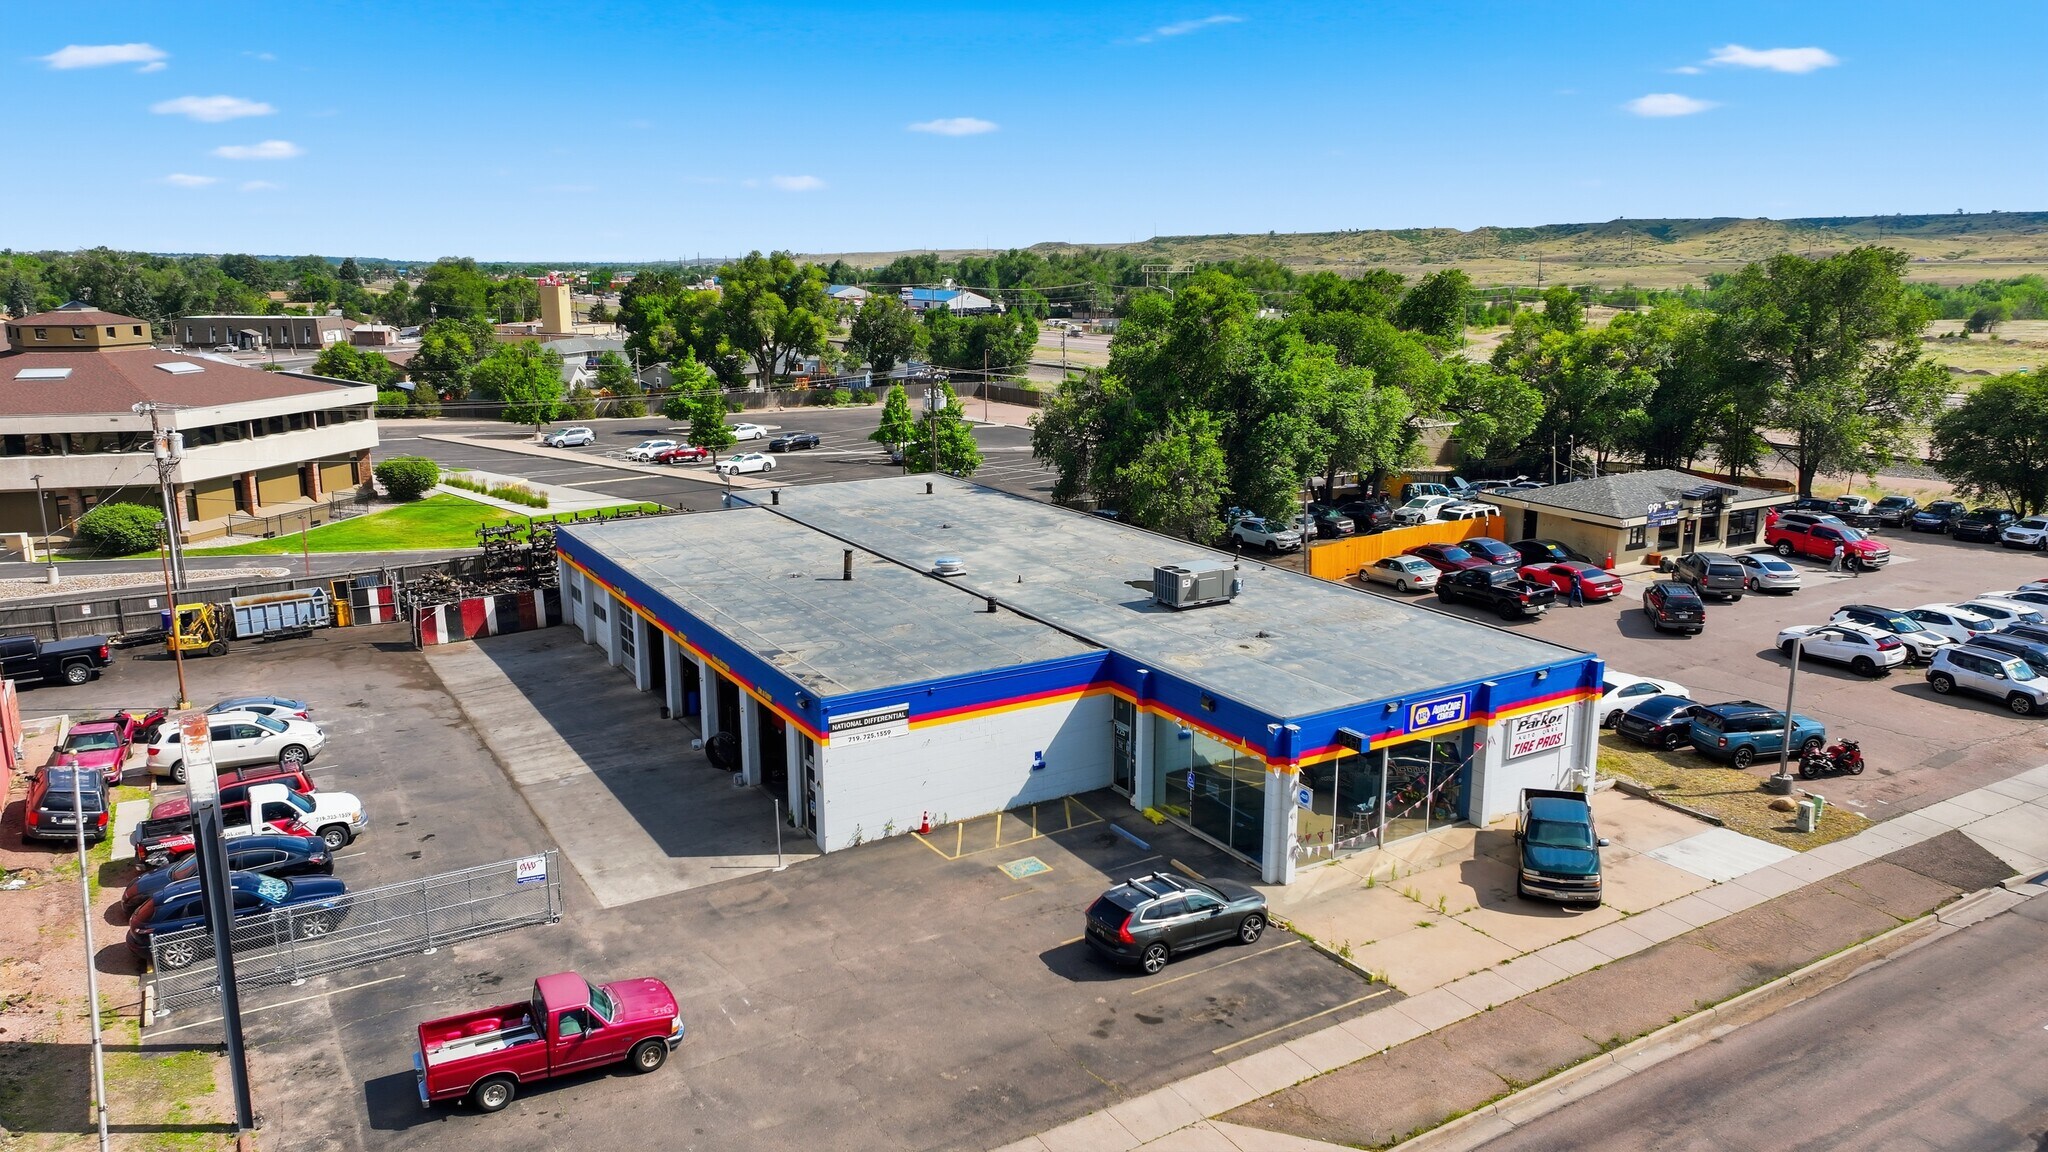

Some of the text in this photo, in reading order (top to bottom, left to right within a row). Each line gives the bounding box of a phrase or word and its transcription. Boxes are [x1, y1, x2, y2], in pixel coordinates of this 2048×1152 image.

[832, 711, 906, 731] NATIONAL DIFFERENTIAL
[848, 729, 892, 742] 719.725.1559
[1512, 733, 1563, 756] TIRE PROS
